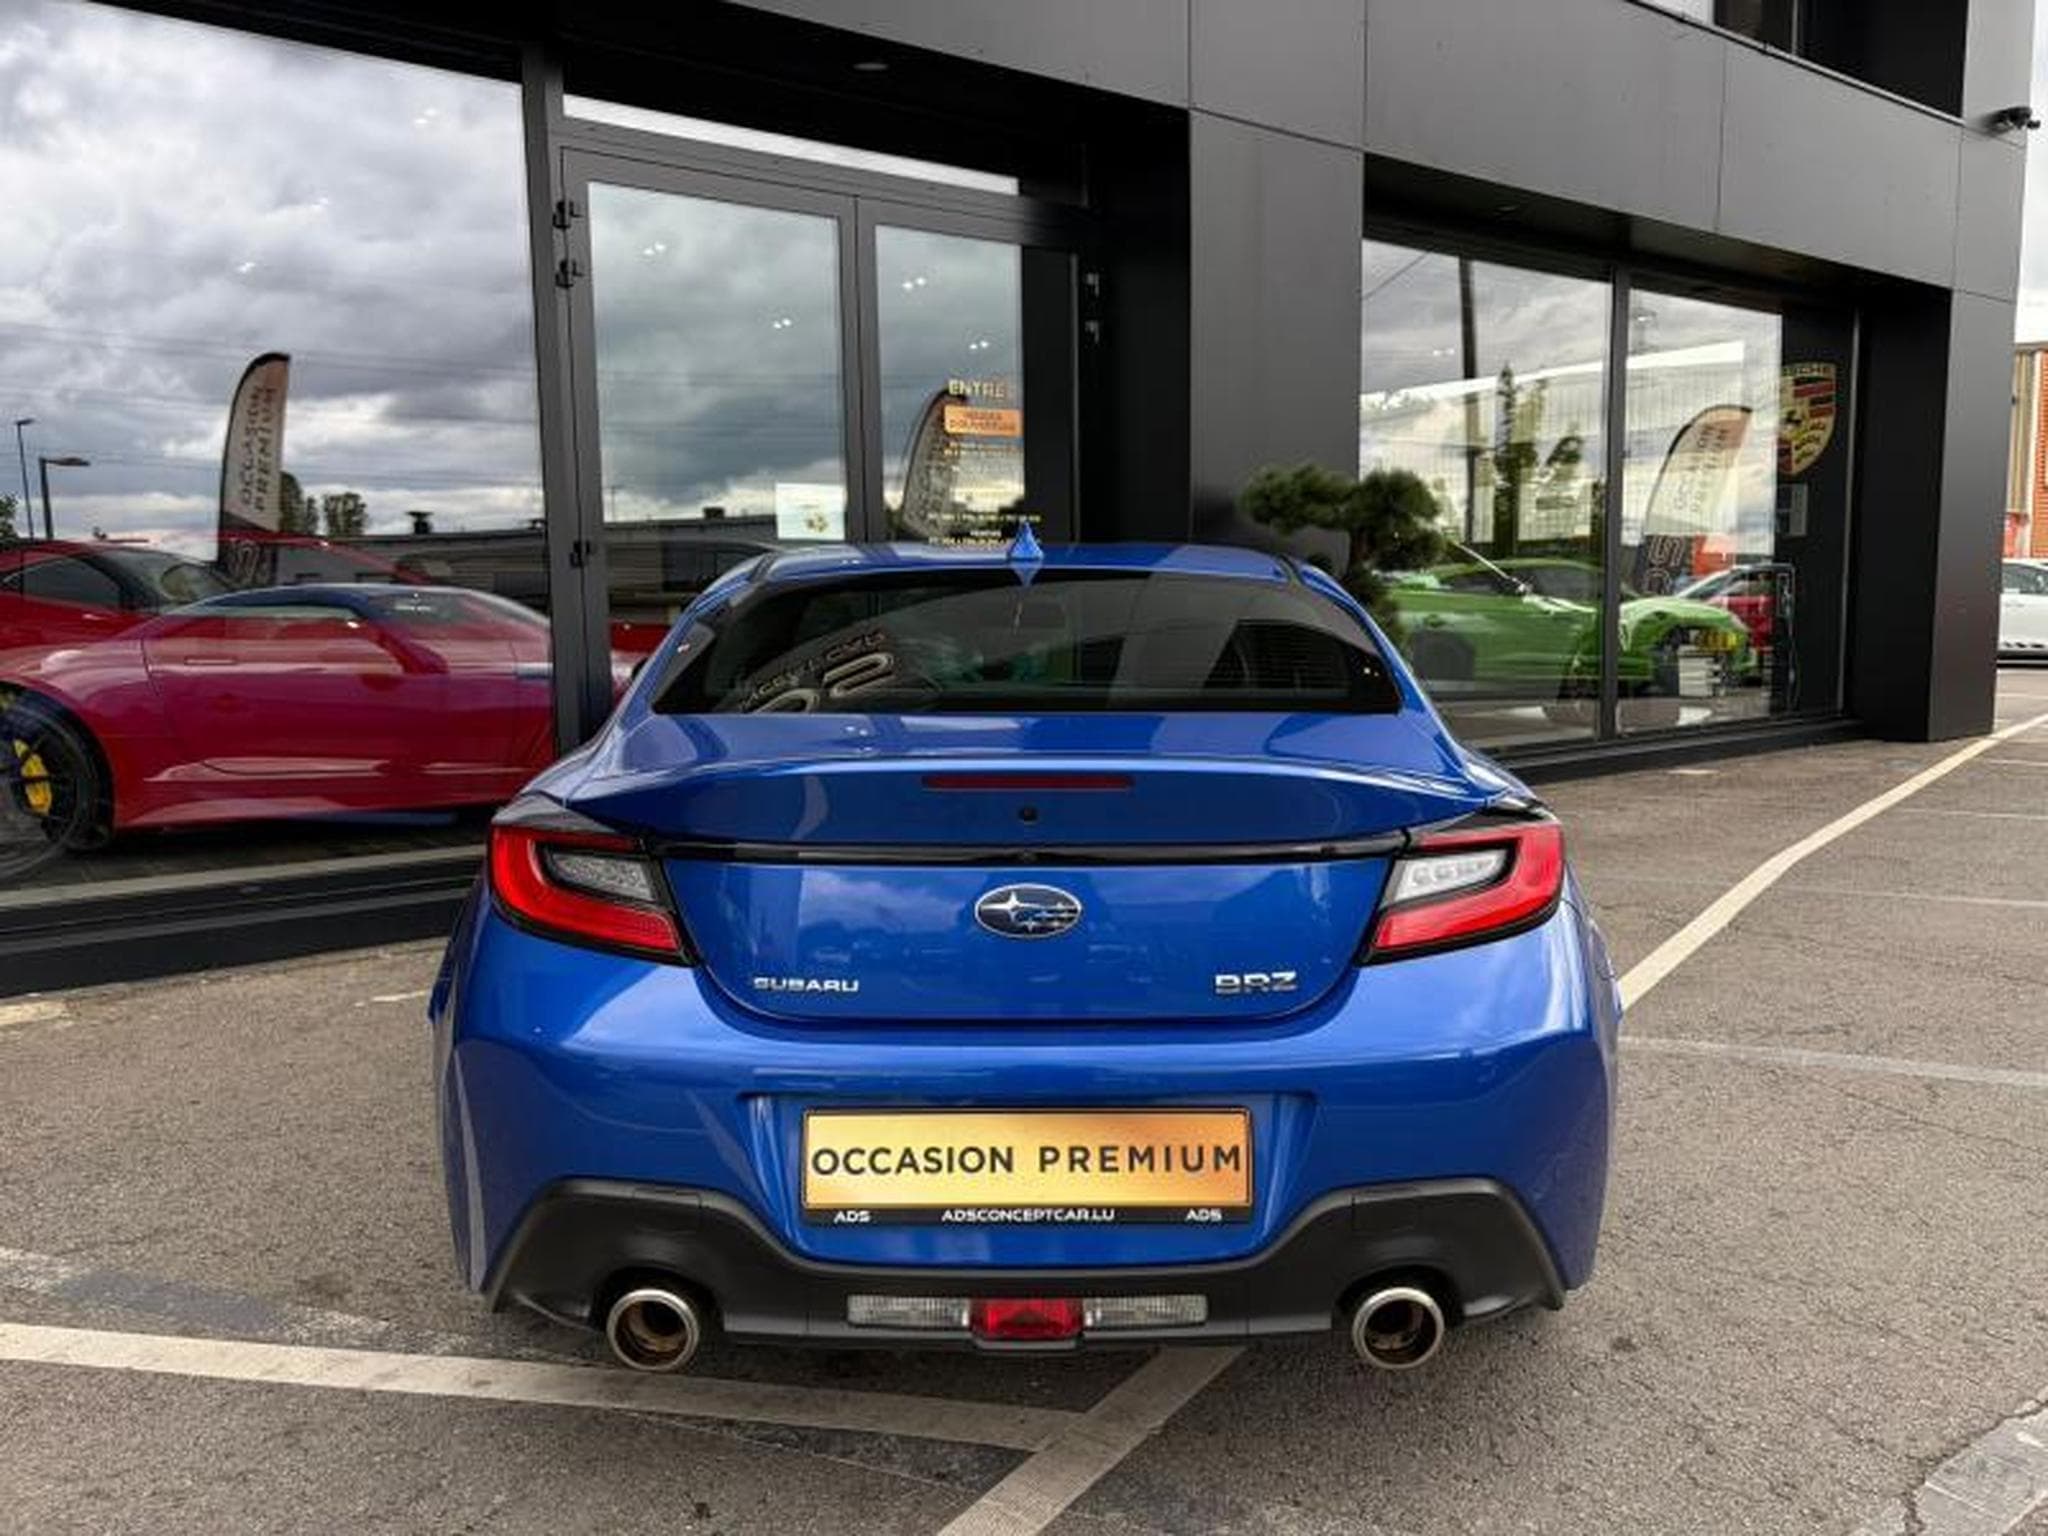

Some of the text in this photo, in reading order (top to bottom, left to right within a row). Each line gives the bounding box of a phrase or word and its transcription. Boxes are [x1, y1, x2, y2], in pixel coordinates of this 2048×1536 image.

[753, 977, 860, 993] SUBARU
[1215, 971, 1297, 995] BRZ
[811, 1145, 1240, 1175] OCCASION PREMIUM
[834, 1207, 1222, 1223] ADS ADSCONCEPTCAR.LU ADS
